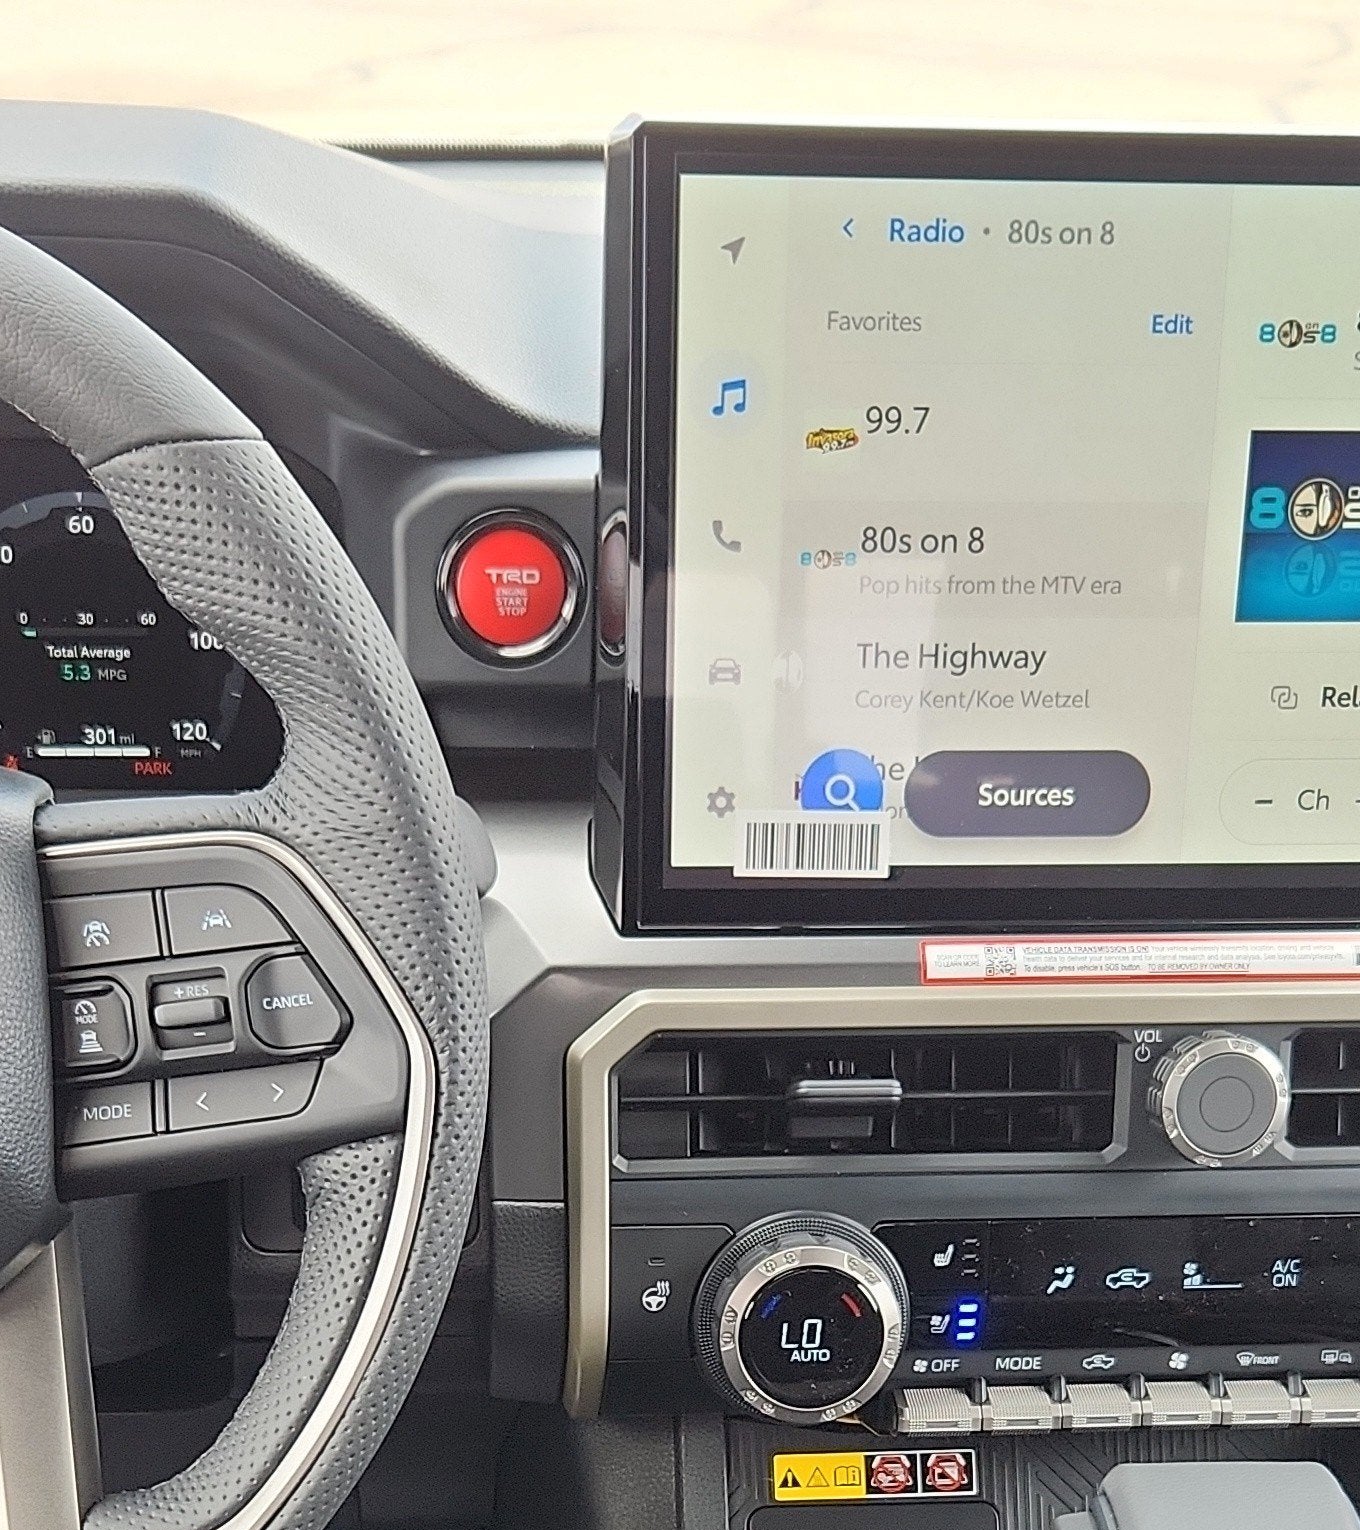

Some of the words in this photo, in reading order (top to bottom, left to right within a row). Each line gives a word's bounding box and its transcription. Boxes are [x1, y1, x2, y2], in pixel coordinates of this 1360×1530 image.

[889, 218, 964, 244] Radio
[1008, 221, 1052, 246] 80s
[1059, 227, 1091, 246] on
[1100, 221, 1115, 246] 8
[827, 310, 922, 333] Favorites
[1151, 314, 1194, 335] Edit
[865, 406, 931, 435] 99.7
[68, 515, 94, 534] 60
[861, 527, 912, 555] 80s
[921, 534, 958, 554] on
[967, 527, 985, 555] 8
[485, 568, 541, 585] TRD
[496, 588, 528, 597] ENGINE
[859, 576, 900, 599] Pop
[905, 575, 942, 596] hits
[948, 575, 996, 596] from
[1002, 576, 1036, 596] the
[1041, 576, 1086, 596] MTV
[1090, 580, 1122, 596] era
[496, 597, 528, 607] START
[77, 613, 94, 626] 30
[140, 613, 157, 626] 60
[498, 606, 527, 616] STOP
[48, 645, 79, 659] Total
[81, 645, 131, 661] Average
[857, 643, 910, 670] The
[918, 643, 1047, 677] Highway
[61, 664, 92, 681] 5.3
[97, 669, 127, 681] MPG
[855, 690, 913, 714] Corey
[919, 690, 1015, 712] Kent/Koe
[1020, 689, 1091, 710] Wetzel
[83, 728, 117, 745] 301
[171, 722, 208, 741] 120
[134, 762, 172, 776] PARK
[977, 783, 1075, 807] Sources
[1297, 788, 1330, 812] Ch
[262, 993, 314, 1011] CANCEL
[75, 1014, 99, 1024] MODE
[1133, 1029, 1163, 1043] VOL
[83, 1103, 132, 1121] MODE
[1272, 1259, 1301, 1274] A/C
[1272, 1274, 1298, 1288] ON
[781, 1319, 822, 1349] LO
[790, 1348, 830, 1363] AUTO
[995, 1356, 1042, 1371] MODE
[1252, 1355, 1280, 1365] FRONT
[931, 1358, 961, 1373] OFF
